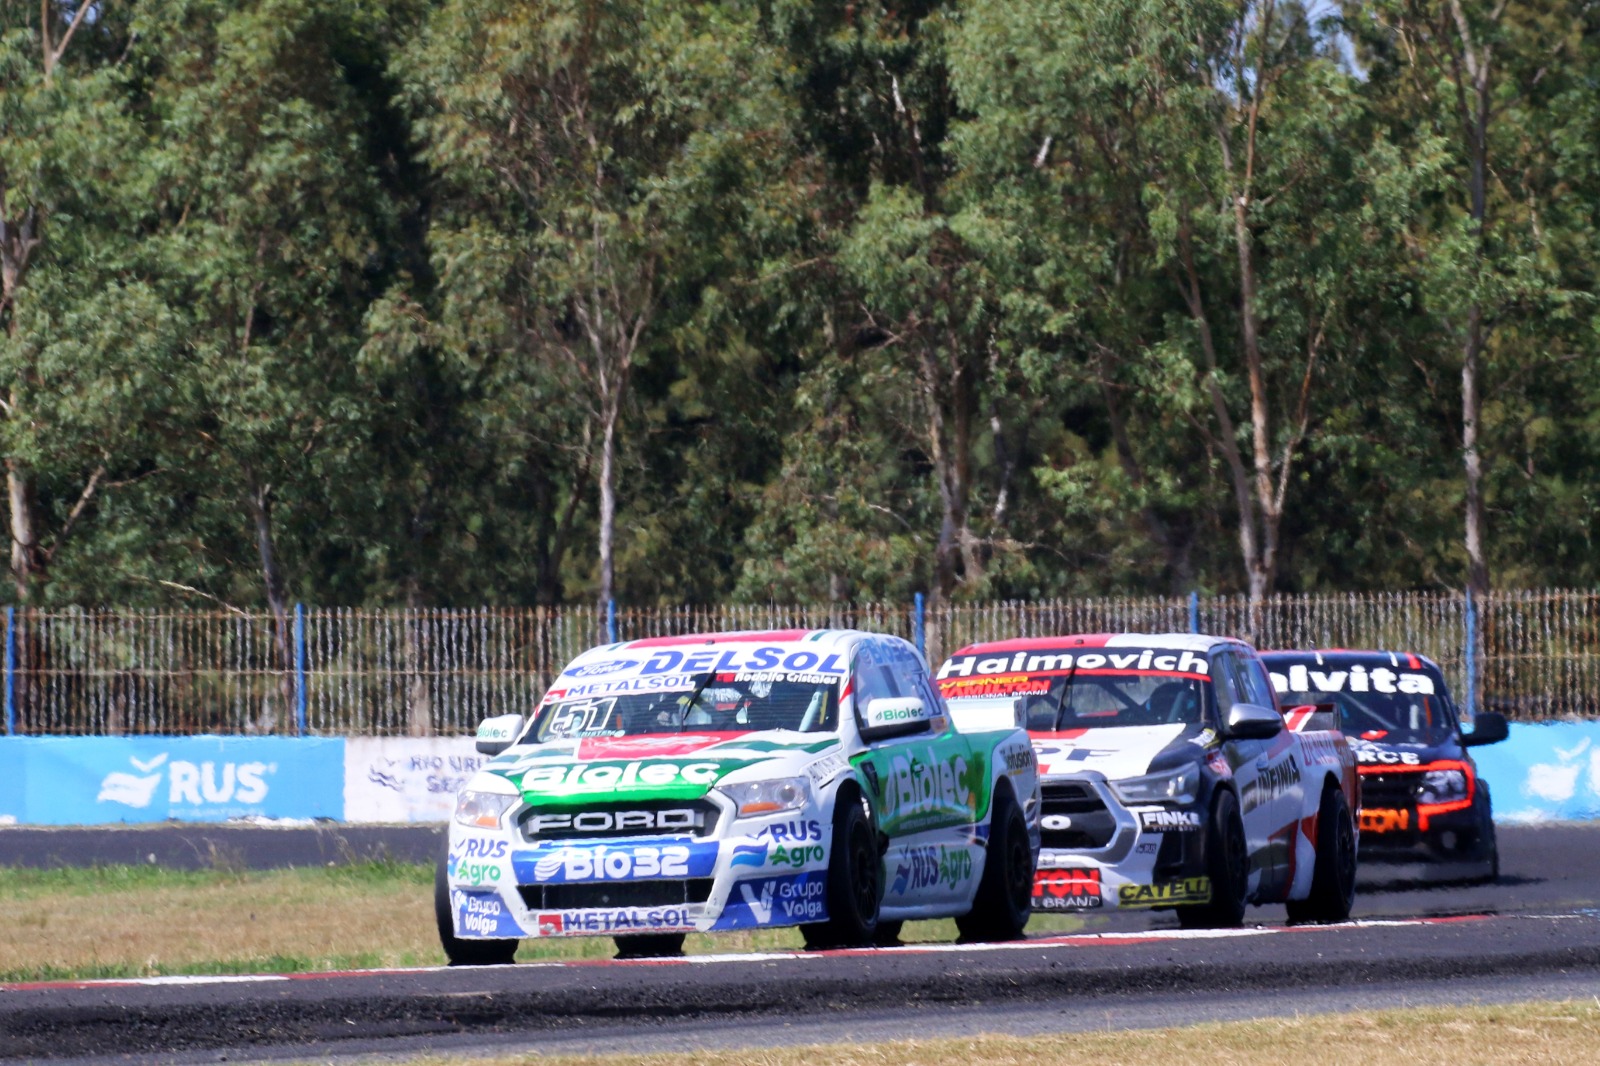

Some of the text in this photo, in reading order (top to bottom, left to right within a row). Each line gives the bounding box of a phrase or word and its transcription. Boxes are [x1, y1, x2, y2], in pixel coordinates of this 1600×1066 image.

[640, 647, 847, 674] DELSOL
[936, 649, 1209, 681] Haimovich
[567, 675, 695, 697] METALSOL
[884, 707, 923, 721] Biolec
[169, 760, 269, 805] RUS
[521, 762, 721, 793] Biolec
[897, 747, 969, 816] Biolec
[528, 809, 704, 835] FORD
[769, 820, 822, 843] RUS
[465, 838, 509, 858] RUS
[769, 844, 824, 868] Agro
[458, 860, 501, 887] Agro
[564, 844, 690, 881] Bio32
[910, 844, 972, 891] RUS Agro
[780, 882, 823, 900] Grupo
[1043, 895, 1100, 909] BRAND
[467, 896, 500, 916] Grupo
[782, 899, 823, 918] Volga
[465, 912, 498, 936] Volga
[563, 908, 696, 932] METALSOL
